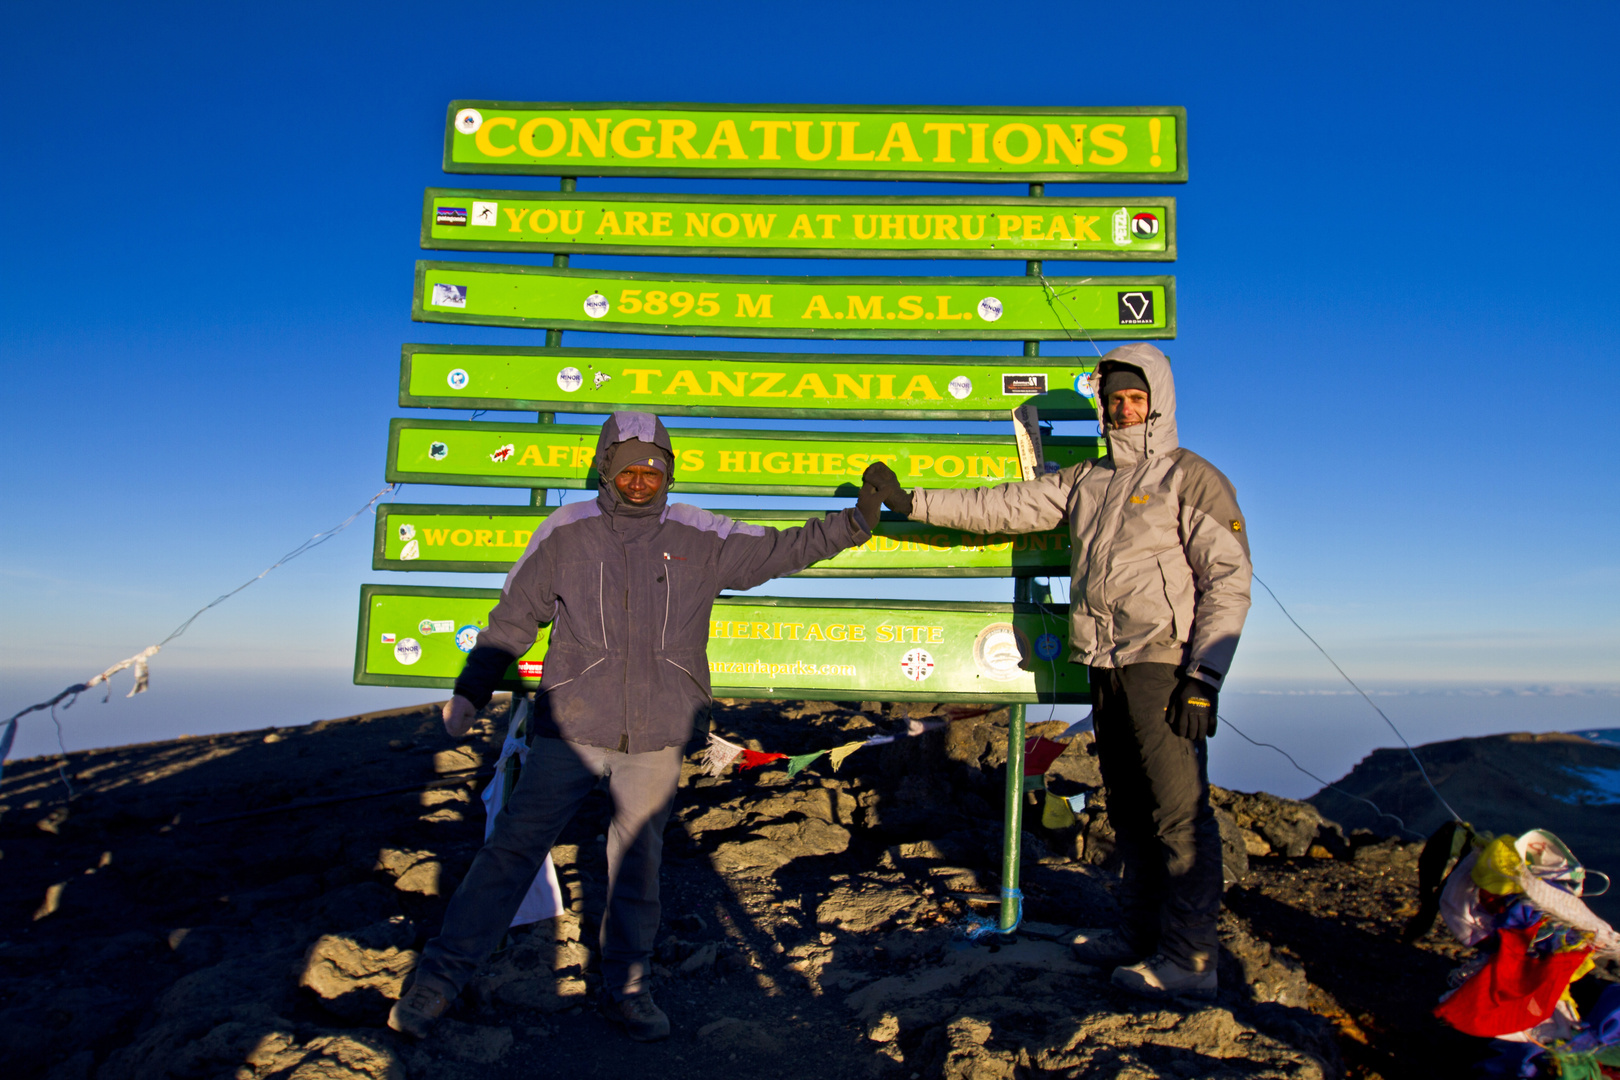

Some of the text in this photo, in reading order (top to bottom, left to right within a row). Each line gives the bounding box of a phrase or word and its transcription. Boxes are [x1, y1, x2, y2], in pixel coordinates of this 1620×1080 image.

[475, 116, 1162, 168] CONGRATULATIONS !
[503, 207, 1102, 241] YOU ARE NOW AT UHURU PEAK
[617, 289, 974, 321] 5895 M A.M.S.L.
[981, 302, 1001, 314] MINOR
[560, 374, 581, 382] MINOR
[621, 368, 944, 400] TANZANIA
[717, 450, 898, 477] HIGHEST
[908, 454, 1024, 479] POINT
[421, 528, 530, 548] WORLD
[851, 534, 951, 552] NDING
[707, 620, 944, 643] HERITAGE SITE
